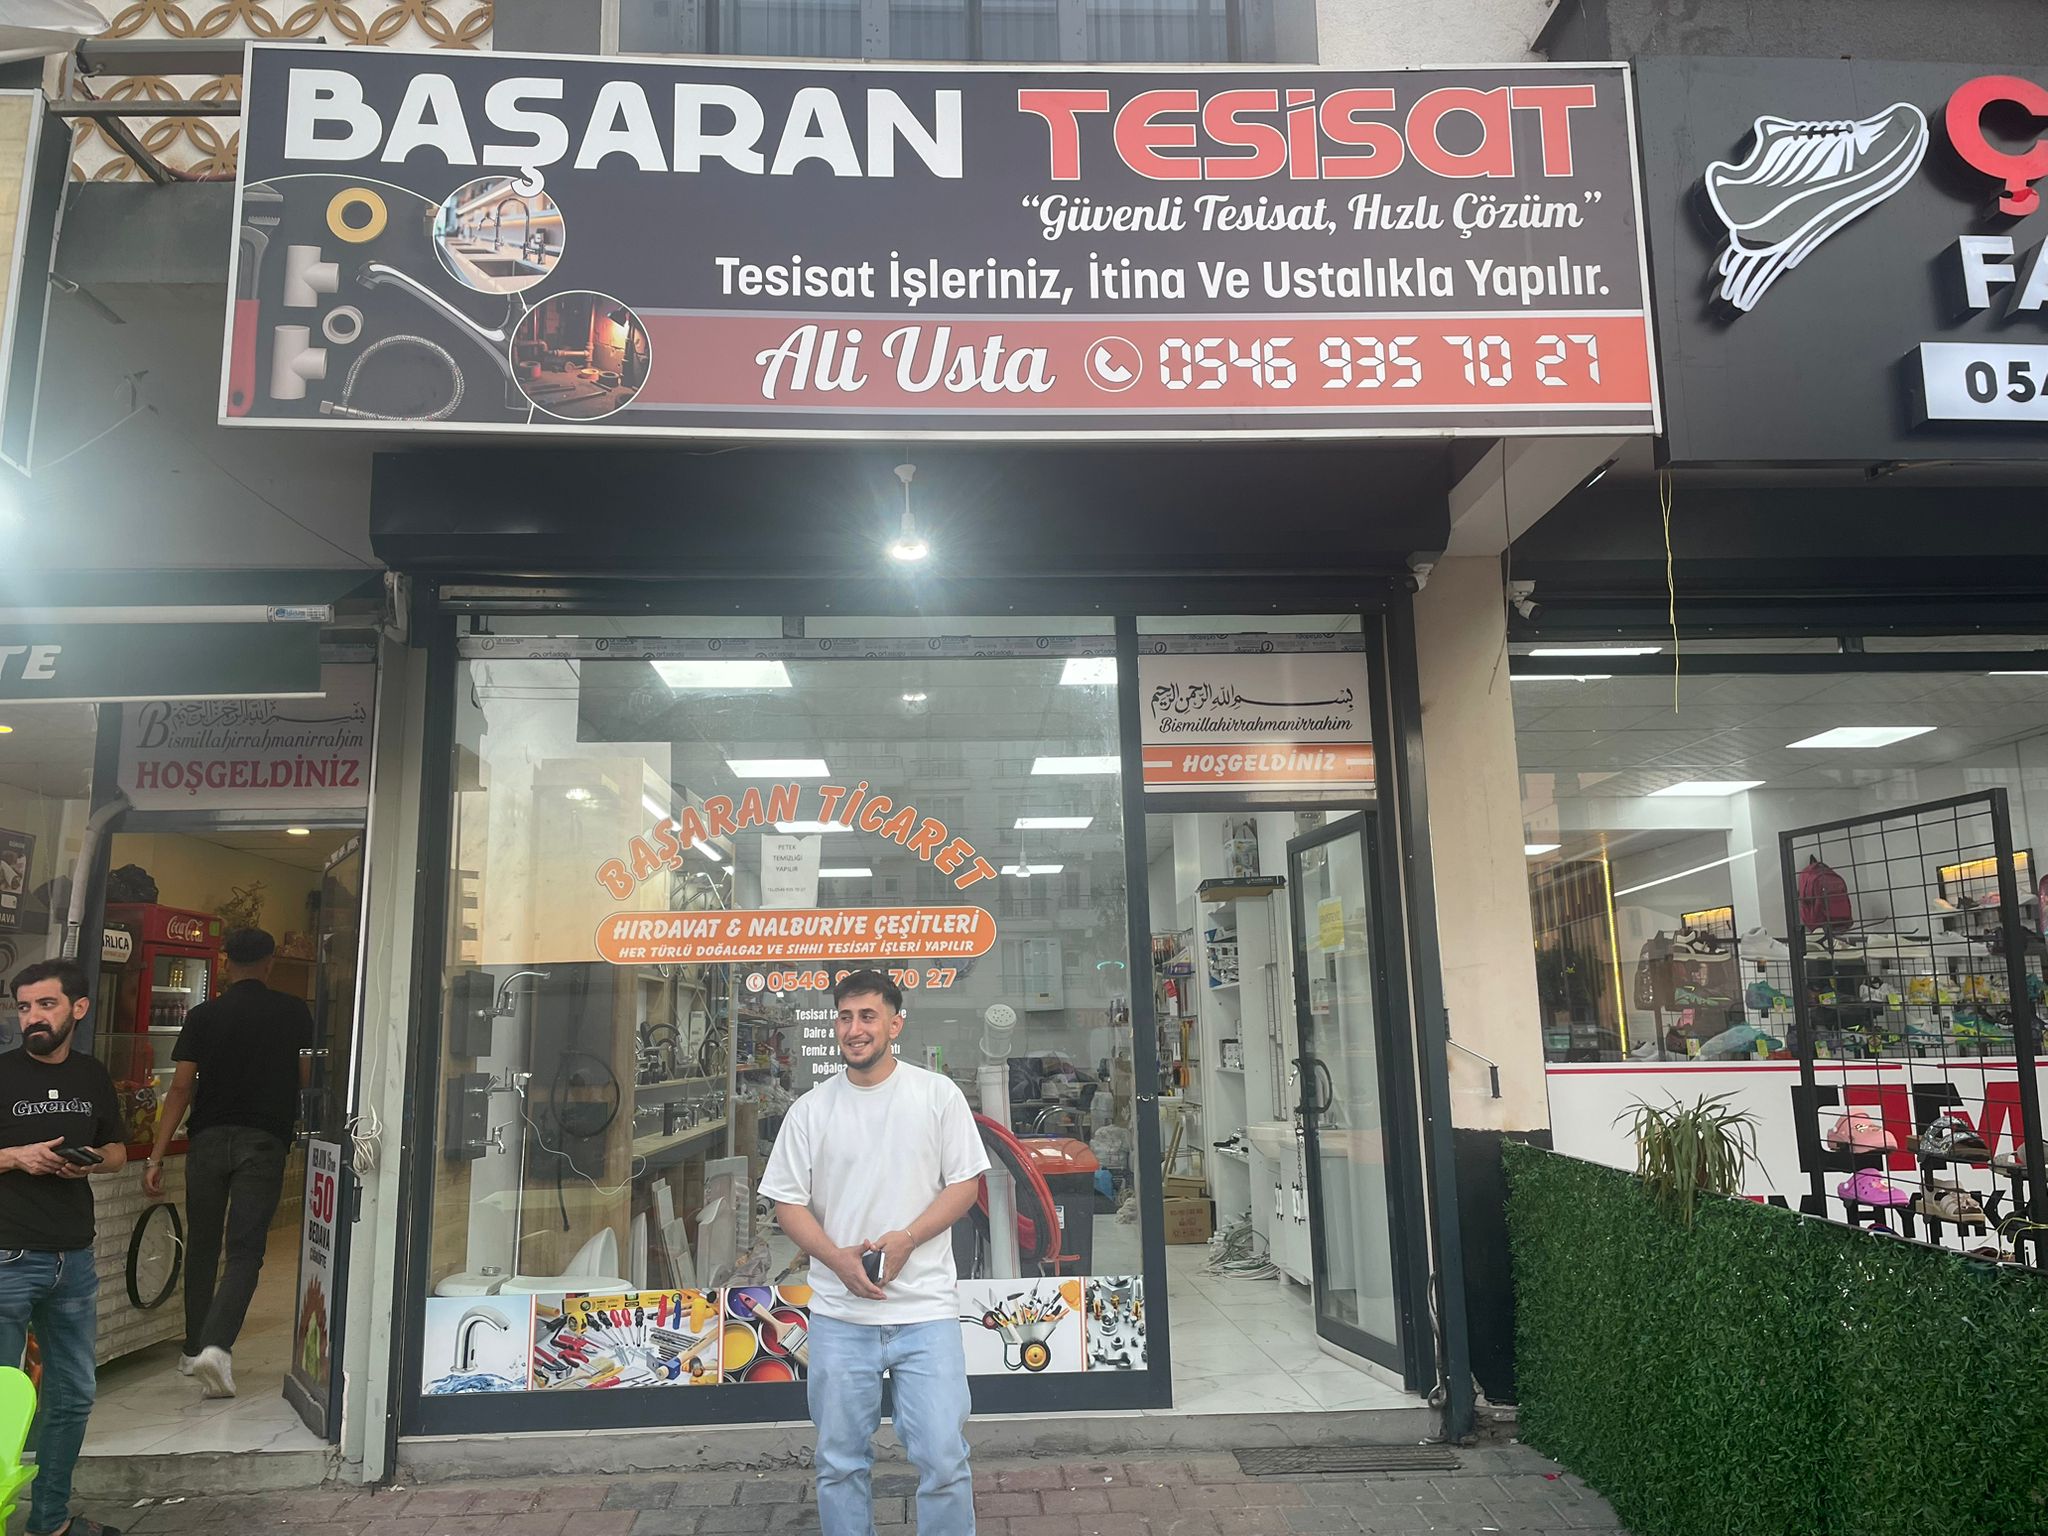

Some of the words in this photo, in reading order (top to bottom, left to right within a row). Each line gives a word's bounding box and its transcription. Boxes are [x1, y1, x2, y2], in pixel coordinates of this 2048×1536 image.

[284, 67, 964, 197] BAŞARAN
[1193, 195, 1337, 236] Tesisat,
[1347, 193, 1442, 231] Hızlı
[715, 255, 875, 298] Tesisat
[890, 251, 1074, 307] İşleriniz,
[1088, 252, 1186, 299] İtina
[1197, 260, 1250, 298] Ve
[1263, 258, 1454, 298] Ustalıkla
[1470, 256, 1611, 305] Yapılır.
[755, 325, 869, 400] Ali
[881, 325, 1057, 394] Usta
[1160, 337, 1298, 391] 0546
[1319, 336, 1422, 390] 935
[1441, 334, 1513, 388] 70
[1535, 333, 1602, 387] 27
[1965, 360, 2048, 404] 05
[136, 700, 364, 752] Bismillahirrahmanirrahim
[1159, 716, 1353, 734] Bismillahirrahmanirrahim
[135, 754, 360, 796] HOŞGELDİNİZ
[1182, 749, 1337, 777] HOŞGELDİNİZ
[596, 783, 801, 901] BAŞARAN
[817, 779, 998, 891] TİCARET
[0, 911, 15, 924] AVA
[613, 918, 721, 941] HIRDAVAT
[726, 917, 741, 938] &
[748, 911, 868, 938] NALBURİYE
[874, 909, 980, 940] ÇEŞİTLERİ
[619, 946, 645, 958] HER
[651, 944, 692, 957] TÜRLÜ
[696, 942, 762, 957] DOĞALGAZ
[767, 944, 783, 955] VE
[828, 940, 876, 953] TESİSAT
[880, 938, 921, 955] İŞLERİ
[925, 940, 974, 952] YAPILIR
[767, 970, 829, 991] 0546
[888, 969, 920, 989] 70
[926, 968, 957, 989] 27
[795, 1008, 828, 1020] Tesisat
[803, 1027, 826, 1039] Daire
[828, 1028, 834, 1038] &
[801, 1045, 827, 1056] Temiz
[829, 1045, 835, 1056] &
[312, 1171, 335, 1224] 50
